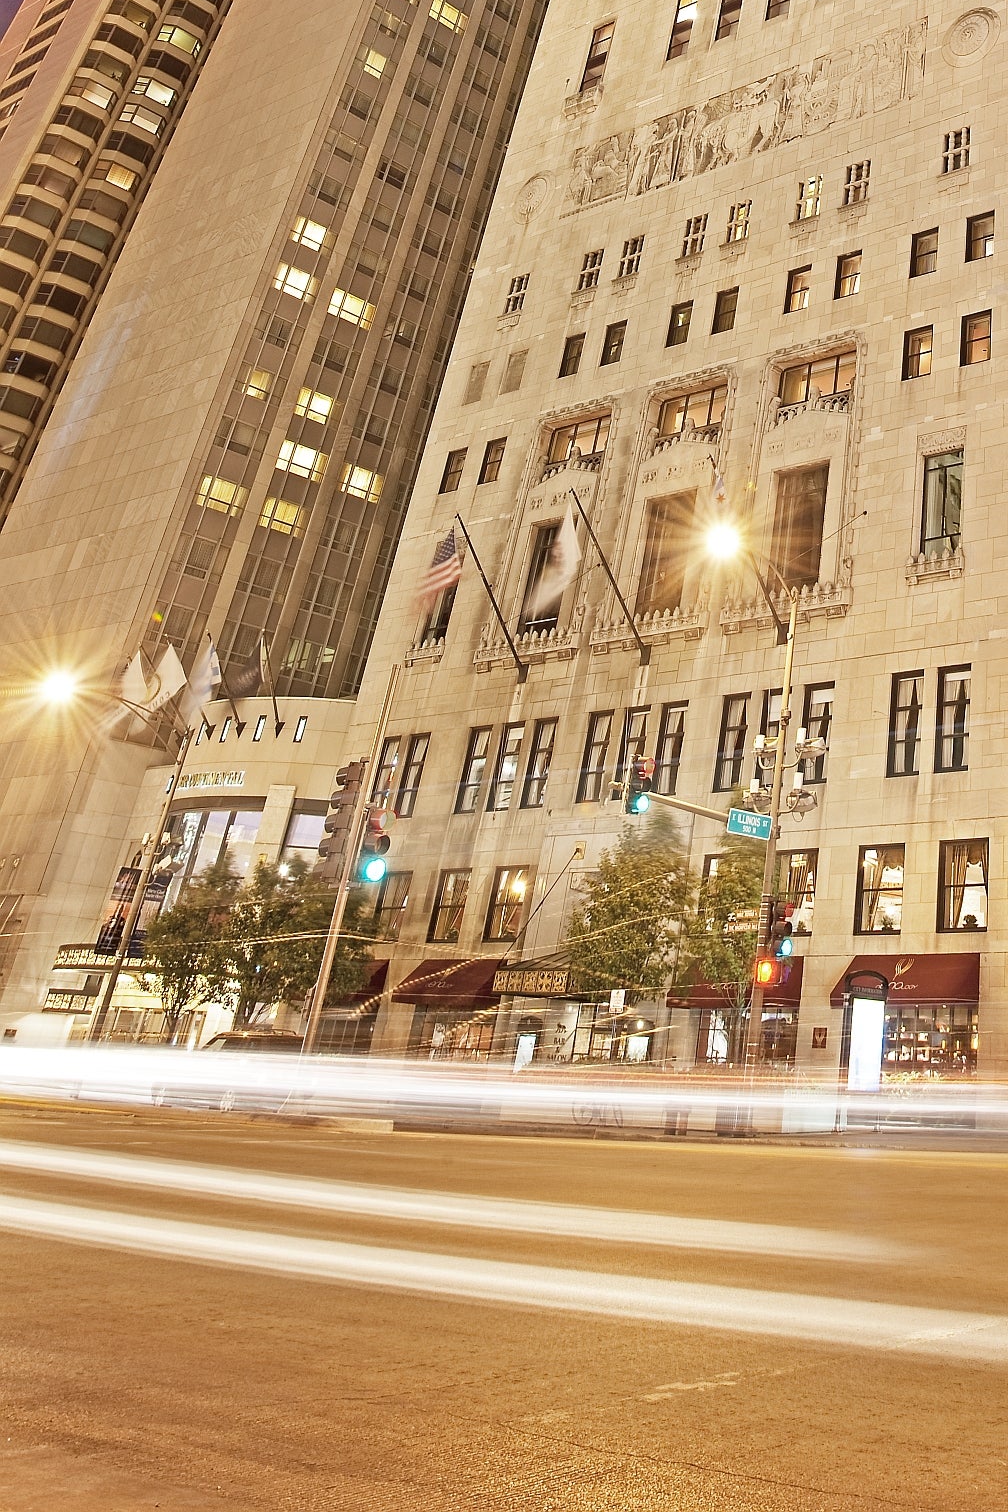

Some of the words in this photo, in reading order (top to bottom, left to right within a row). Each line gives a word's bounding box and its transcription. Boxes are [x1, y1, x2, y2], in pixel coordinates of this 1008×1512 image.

[737, 813, 761, 827] ILLINOIS
[762, 819, 769, 827] ST
[742, 824, 752, 834] 500
[553, 1037, 566, 1046] BAR
